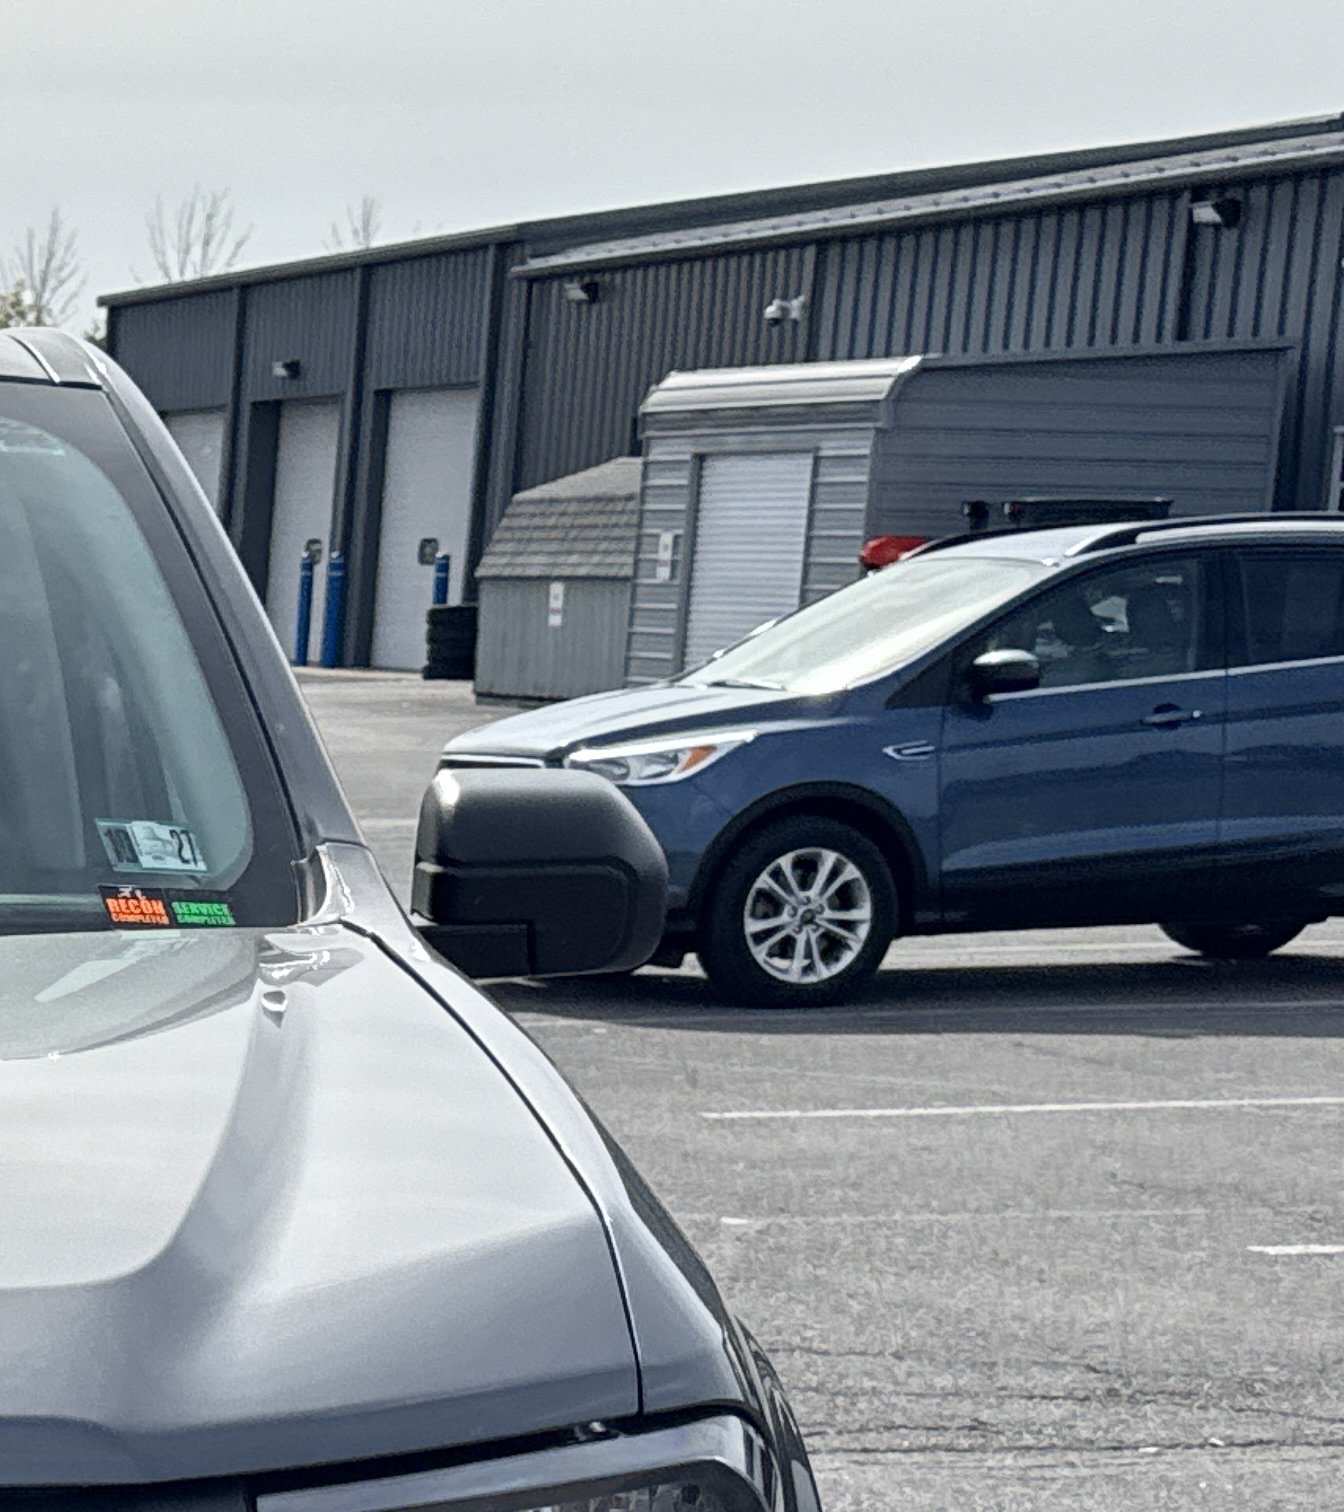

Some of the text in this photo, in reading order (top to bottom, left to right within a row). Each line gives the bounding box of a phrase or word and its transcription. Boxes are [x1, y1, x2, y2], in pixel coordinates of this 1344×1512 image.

[169, 829, 199, 868] 27
[105, 899, 166, 915] RECON
[171, 901, 230, 916] SERVICE
